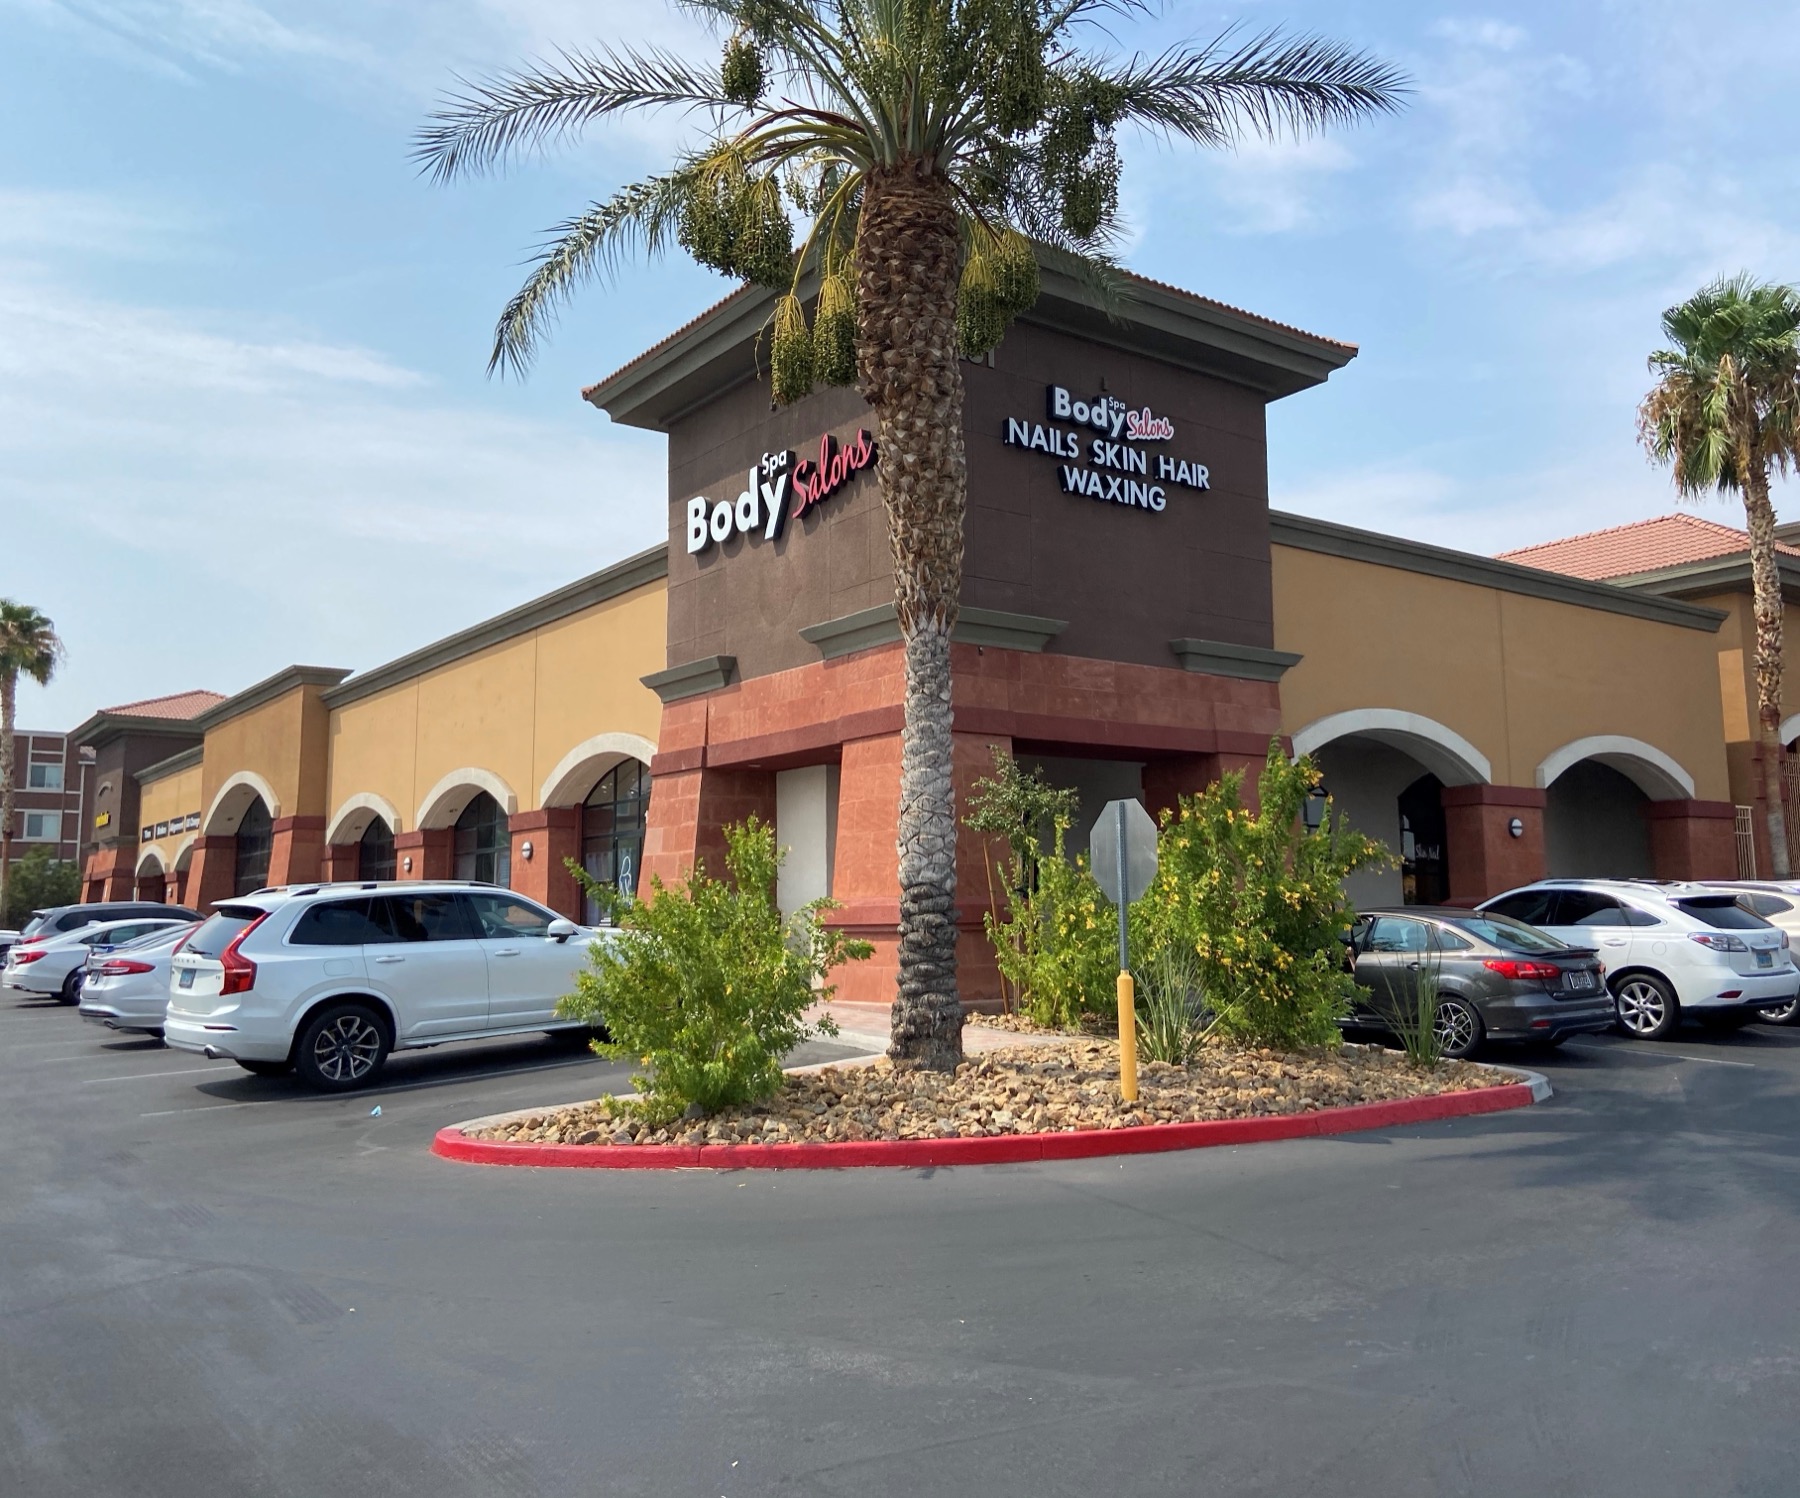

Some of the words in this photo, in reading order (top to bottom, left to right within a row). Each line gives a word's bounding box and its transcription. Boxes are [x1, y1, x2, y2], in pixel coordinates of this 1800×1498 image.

[1054, 386, 1125, 438] Body
[1108, 396, 1126, 411] Spa
[1127, 407, 1174, 440] Salons
[1008, 417, 1079, 459] NAILS
[1093, 439, 1147, 475] SKIN
[1159, 454, 1210, 490] HAIR
[687, 465, 788, 554] Body
[761, 450, 788, 478] Spa
[792, 428, 873, 519] Salons
[1063, 464, 1167, 512] WAXING
